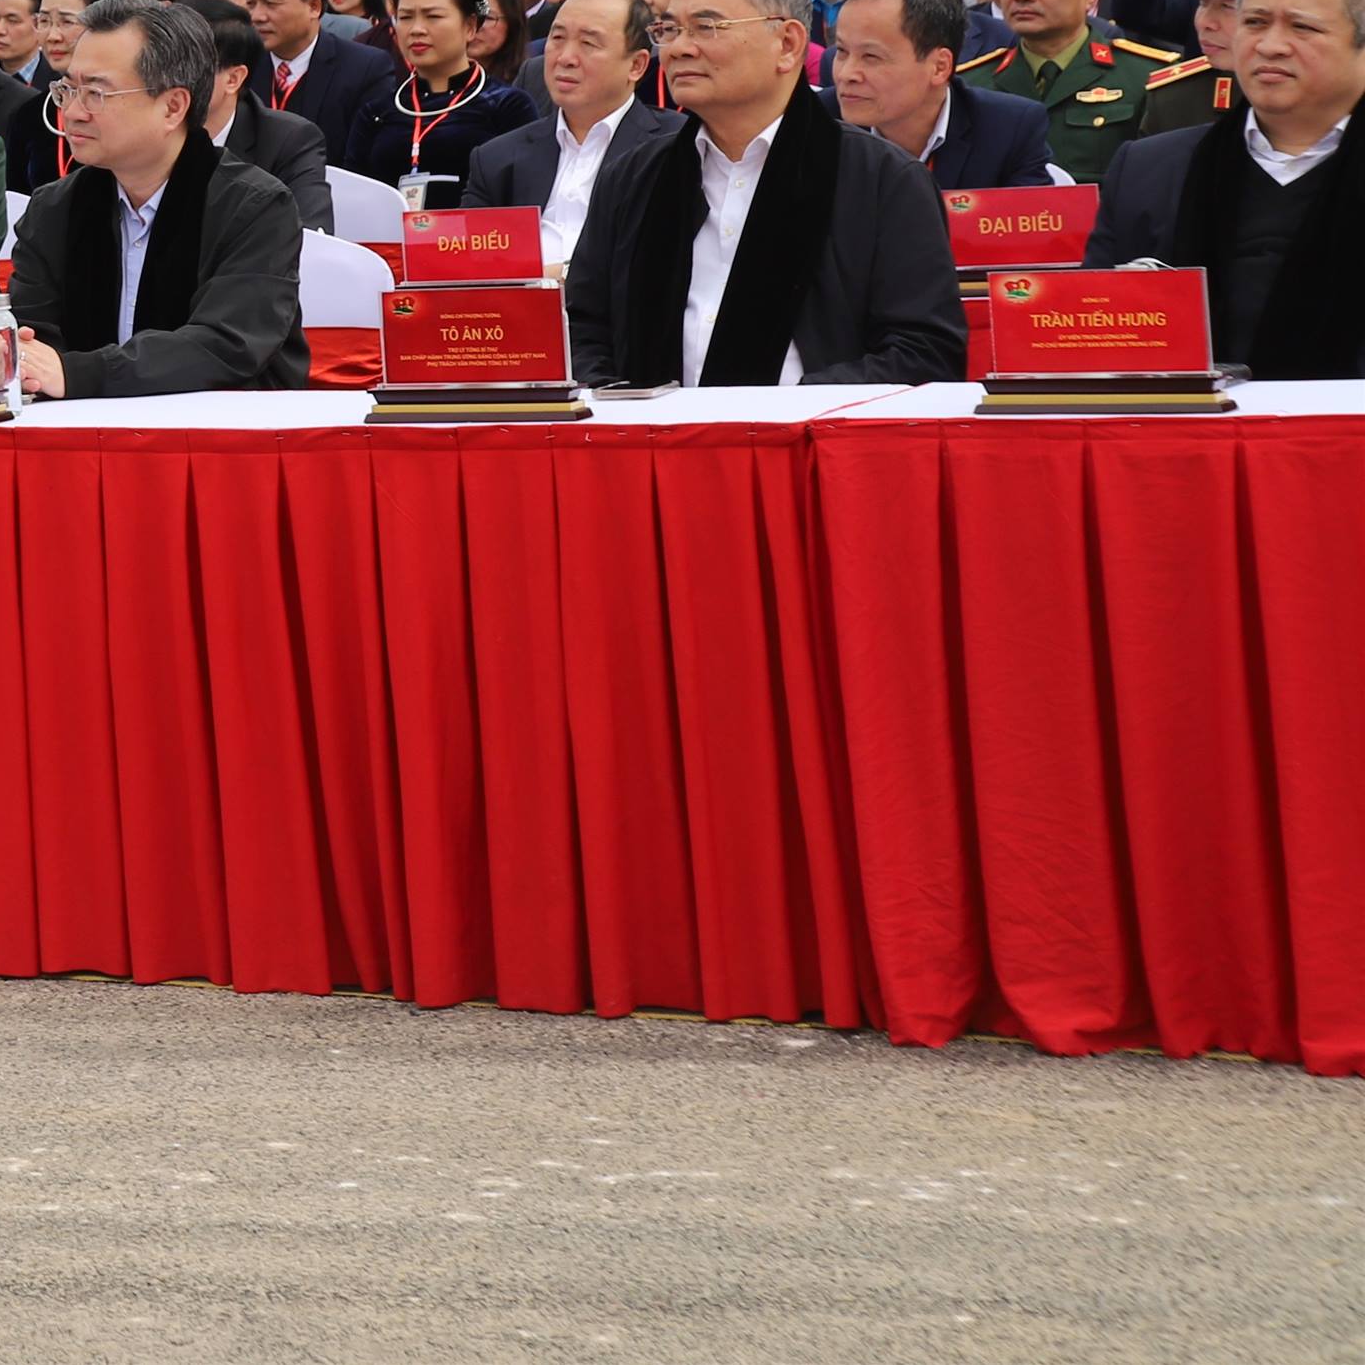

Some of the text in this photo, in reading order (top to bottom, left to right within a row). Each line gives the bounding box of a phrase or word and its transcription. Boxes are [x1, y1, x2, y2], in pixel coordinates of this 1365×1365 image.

[978, 209, 1063, 237] ĐẠI BIỂU
[437, 229, 510, 254] ĐẠI BIỂU
[1030, 309, 1167, 327] TRẦN TIẾN HƯNG
[440, 324, 504, 341] TÔ ÂN XÔ
